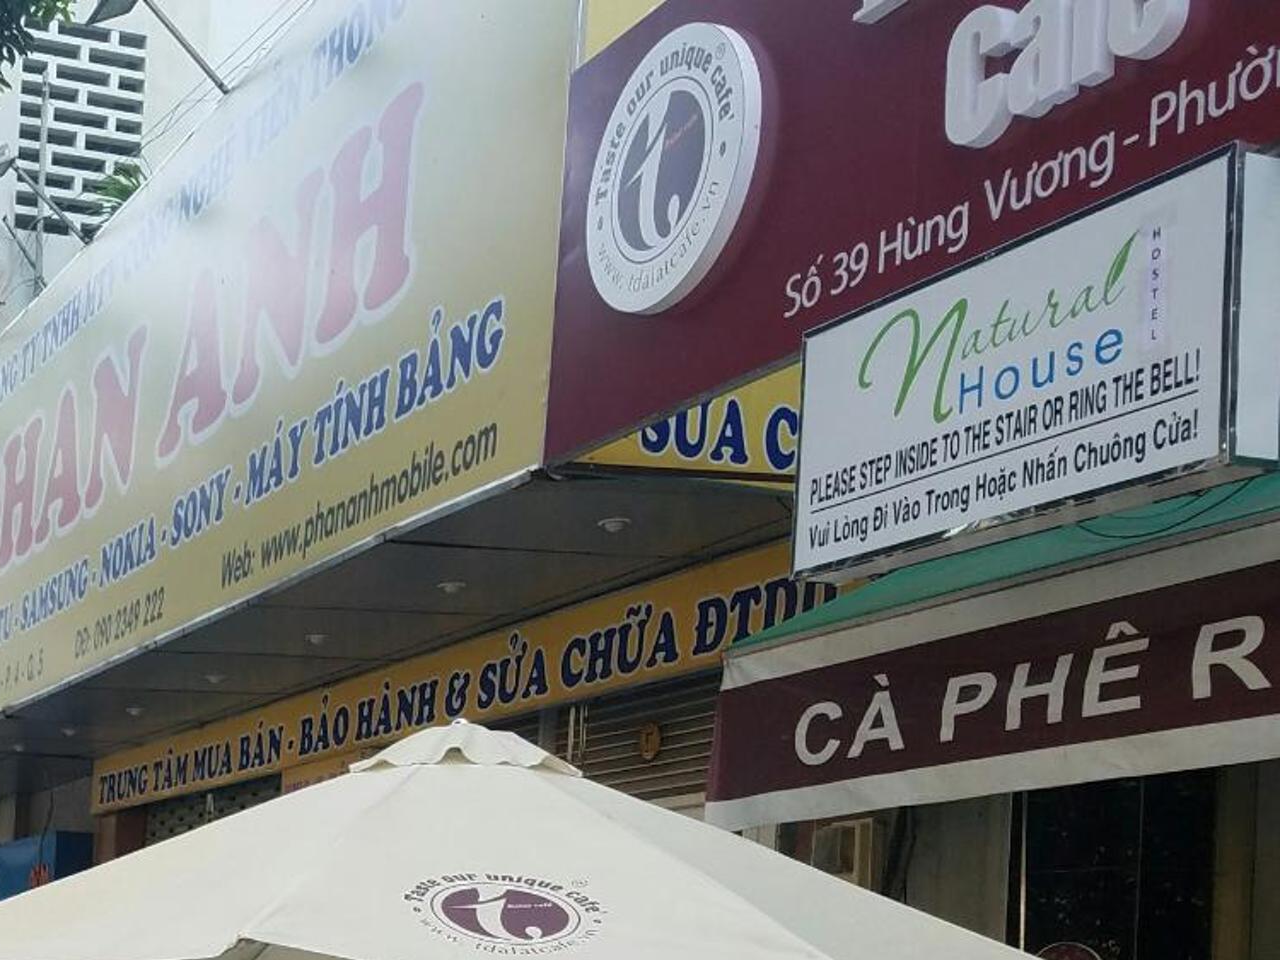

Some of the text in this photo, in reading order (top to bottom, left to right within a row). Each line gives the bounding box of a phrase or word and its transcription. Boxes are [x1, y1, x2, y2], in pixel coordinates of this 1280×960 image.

[626, 68, 655, 117] our
[660, 42, 713, 76] unique
[783, 44, 1280, 318] Số 39 Hùng Vương Phườ
[158, 80, 424, 458] ANH
[858, 228, 1138, 423] Natural
[1149, 226, 1162, 341] HOSTEL
[20, 561, 89, 630] SAMSUNG
[99, 517, 157, 588] NOKIA
[171, 469, 231, 547] SONY
[245, 420, 307, 505] MÁY
[313, 368, 390, 465] TÍNH
[395, 299, 504, 419] BẢNG
[809, 409, 1199, 550] Vui Lòng Đi Vào Trong Hoặc Nhấn Chuông Cửa!
[810, 348, 1200, 505] PLEASE STEP INSIDE TO THE STAIR OR RING THE BELL!
[221, 423, 498, 588] Web: www.phananhmobile.com
[143, 586, 165, 627] 222
[98, 764, 148, 804] TRUNG
[152, 749, 188, 791] TÂM
[192, 740, 232, 782] MUA
[238, 721, 283, 770] BÁN
[298, 696, 349, 756] BẢO
[355, 680, 439, 740] HÀNH
[445, 671, 470, 717] &
[477, 633, 548, 710] SỬA
[561, 603, 679, 689] CHỮA
[794, 615, 1272, 766] CÀ PHÊ R
[485, 873, 564, 891] unique
